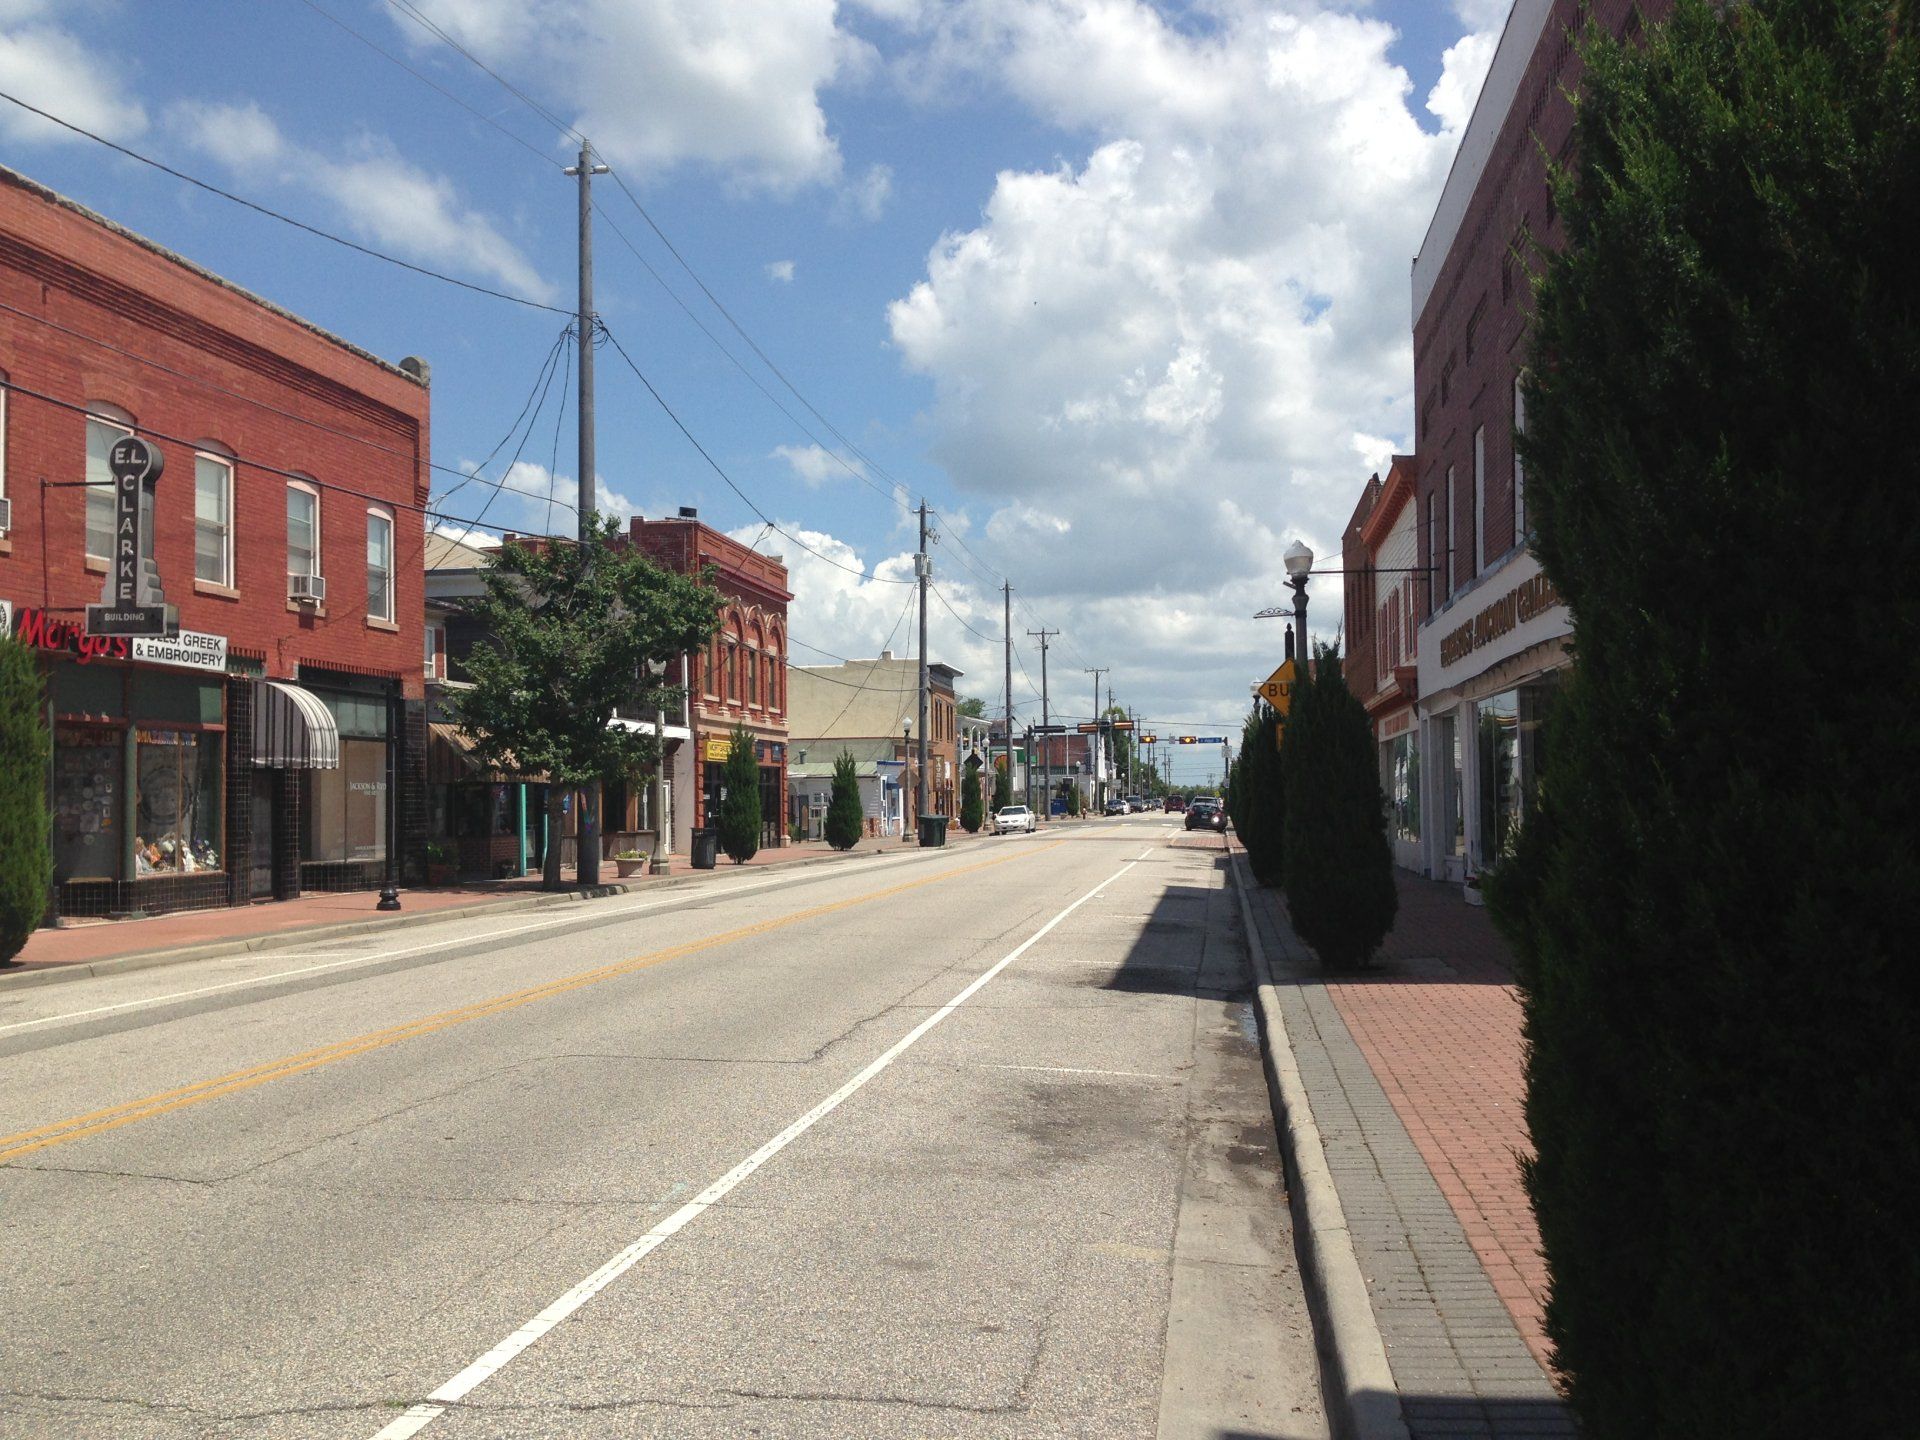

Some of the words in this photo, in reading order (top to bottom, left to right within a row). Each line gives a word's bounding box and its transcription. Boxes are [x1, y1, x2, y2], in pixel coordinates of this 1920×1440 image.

[115, 447, 146, 464] E.L.
[119, 474, 135, 599] CLARKE
[104, 612, 145, 622] BUILDING
[183, 633, 221, 651] GREEK
[135, 643, 144, 657] &
[147, 645, 223, 667] EMBROIDERY
